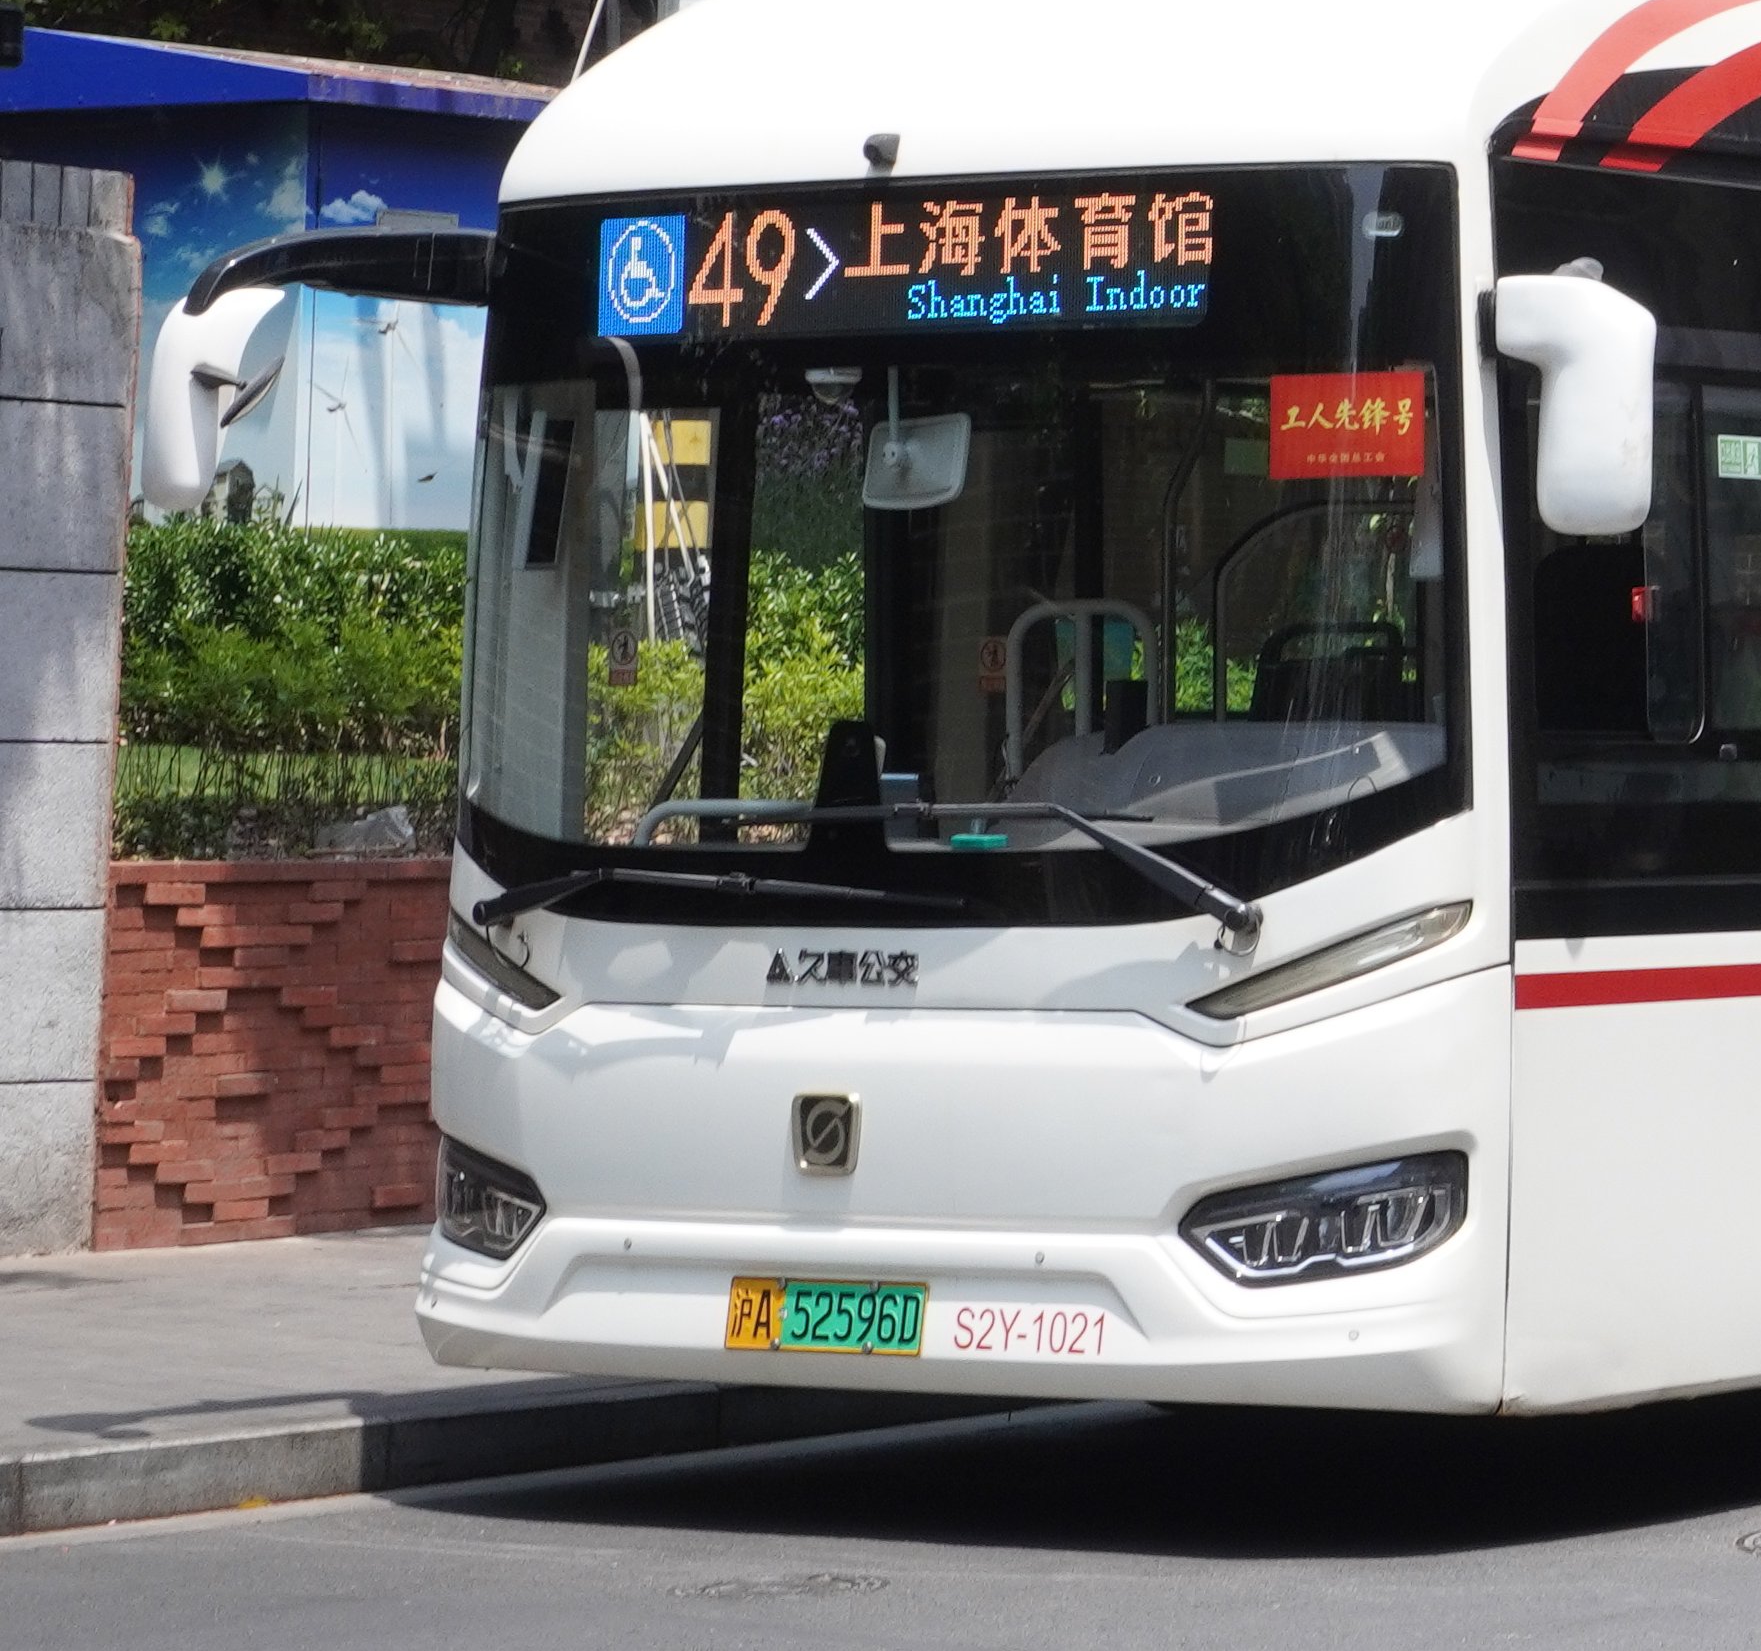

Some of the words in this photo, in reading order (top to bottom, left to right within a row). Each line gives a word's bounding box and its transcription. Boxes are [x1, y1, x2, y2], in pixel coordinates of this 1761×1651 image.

[687, 209, 796, 328] 49
[843, 191, 1214, 279] 上海体育馆
[906, 273, 1063, 325] Shanghai
[1085, 270, 1205, 312] Indoor
[1279, 396, 1414, 437] 工人先锋号
[789, 1290, 921, 1345] 52596D
[953, 1306, 1106, 1356] S2Y-1021
